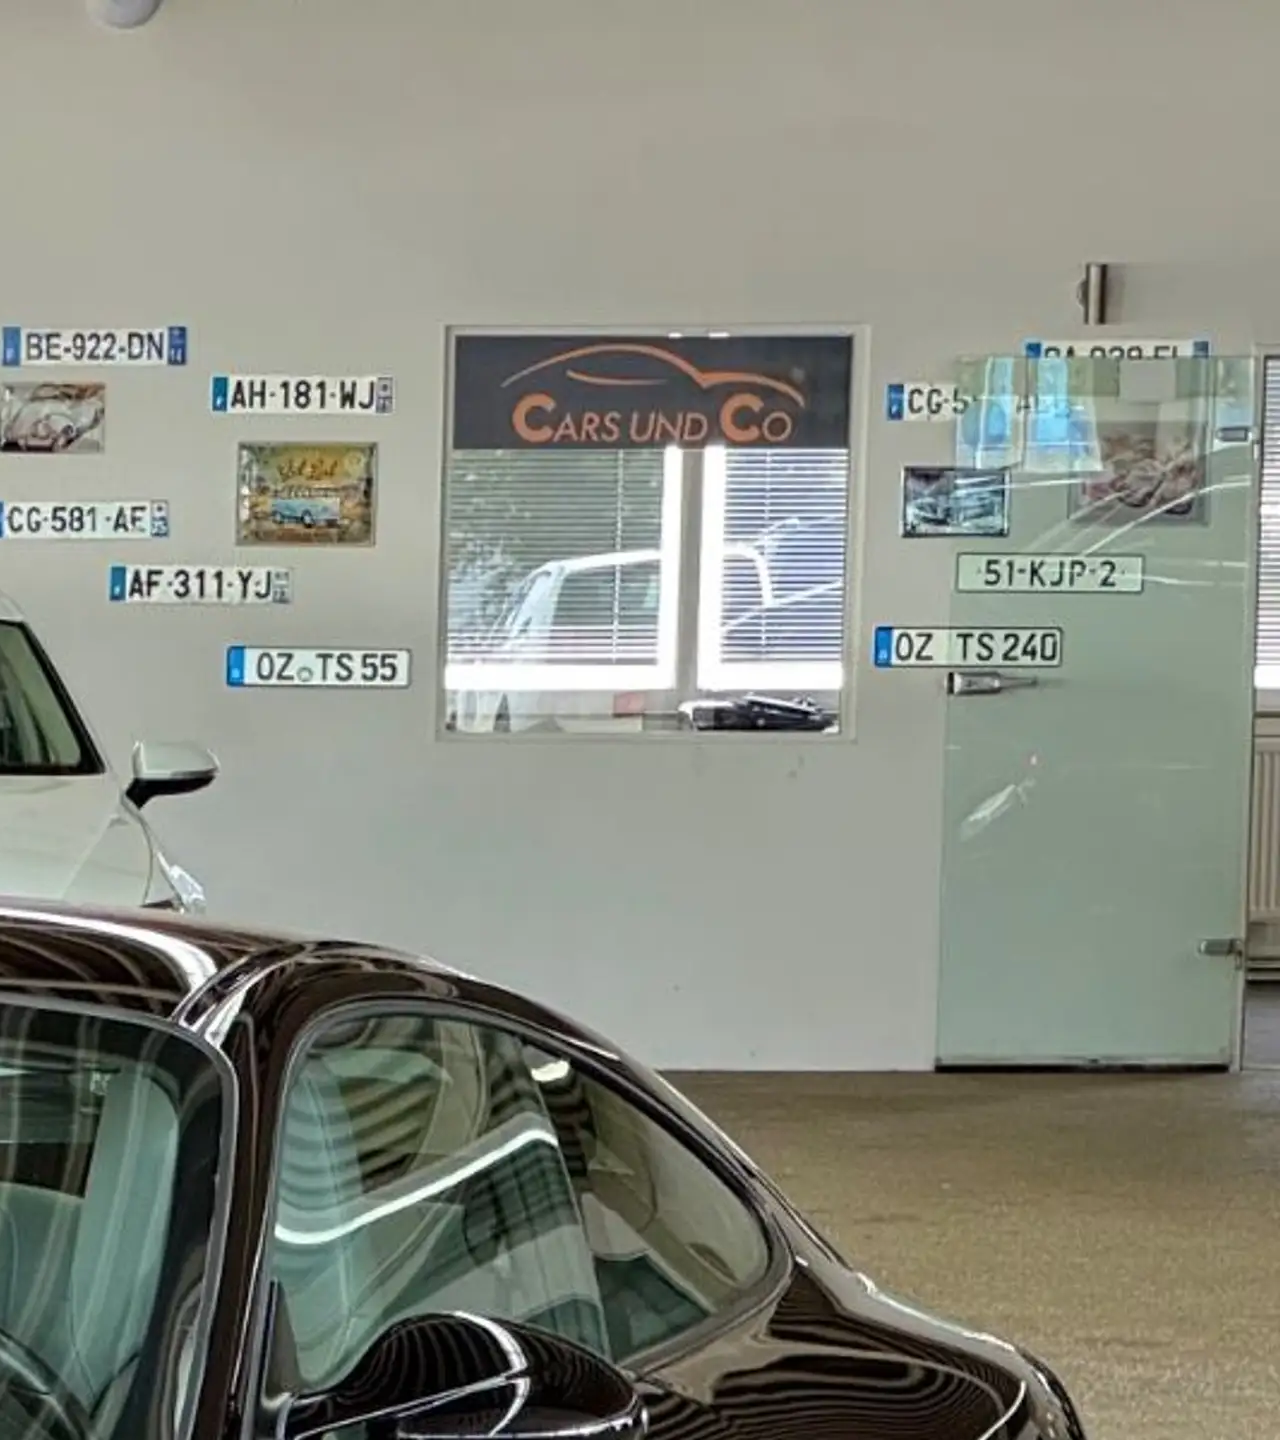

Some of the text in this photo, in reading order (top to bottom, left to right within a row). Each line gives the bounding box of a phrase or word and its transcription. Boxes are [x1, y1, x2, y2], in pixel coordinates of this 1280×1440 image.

[26, 332, 164, 360] BE-922-DN
[231, 379, 375, 409] AH-181-WJ
[129, 569, 272, 599] AF-311-YJ
[984, 559, 1117, 587] 51-KJP-2
[896, 632, 933, 661] OZ
[257, 652, 294, 681] OZ
